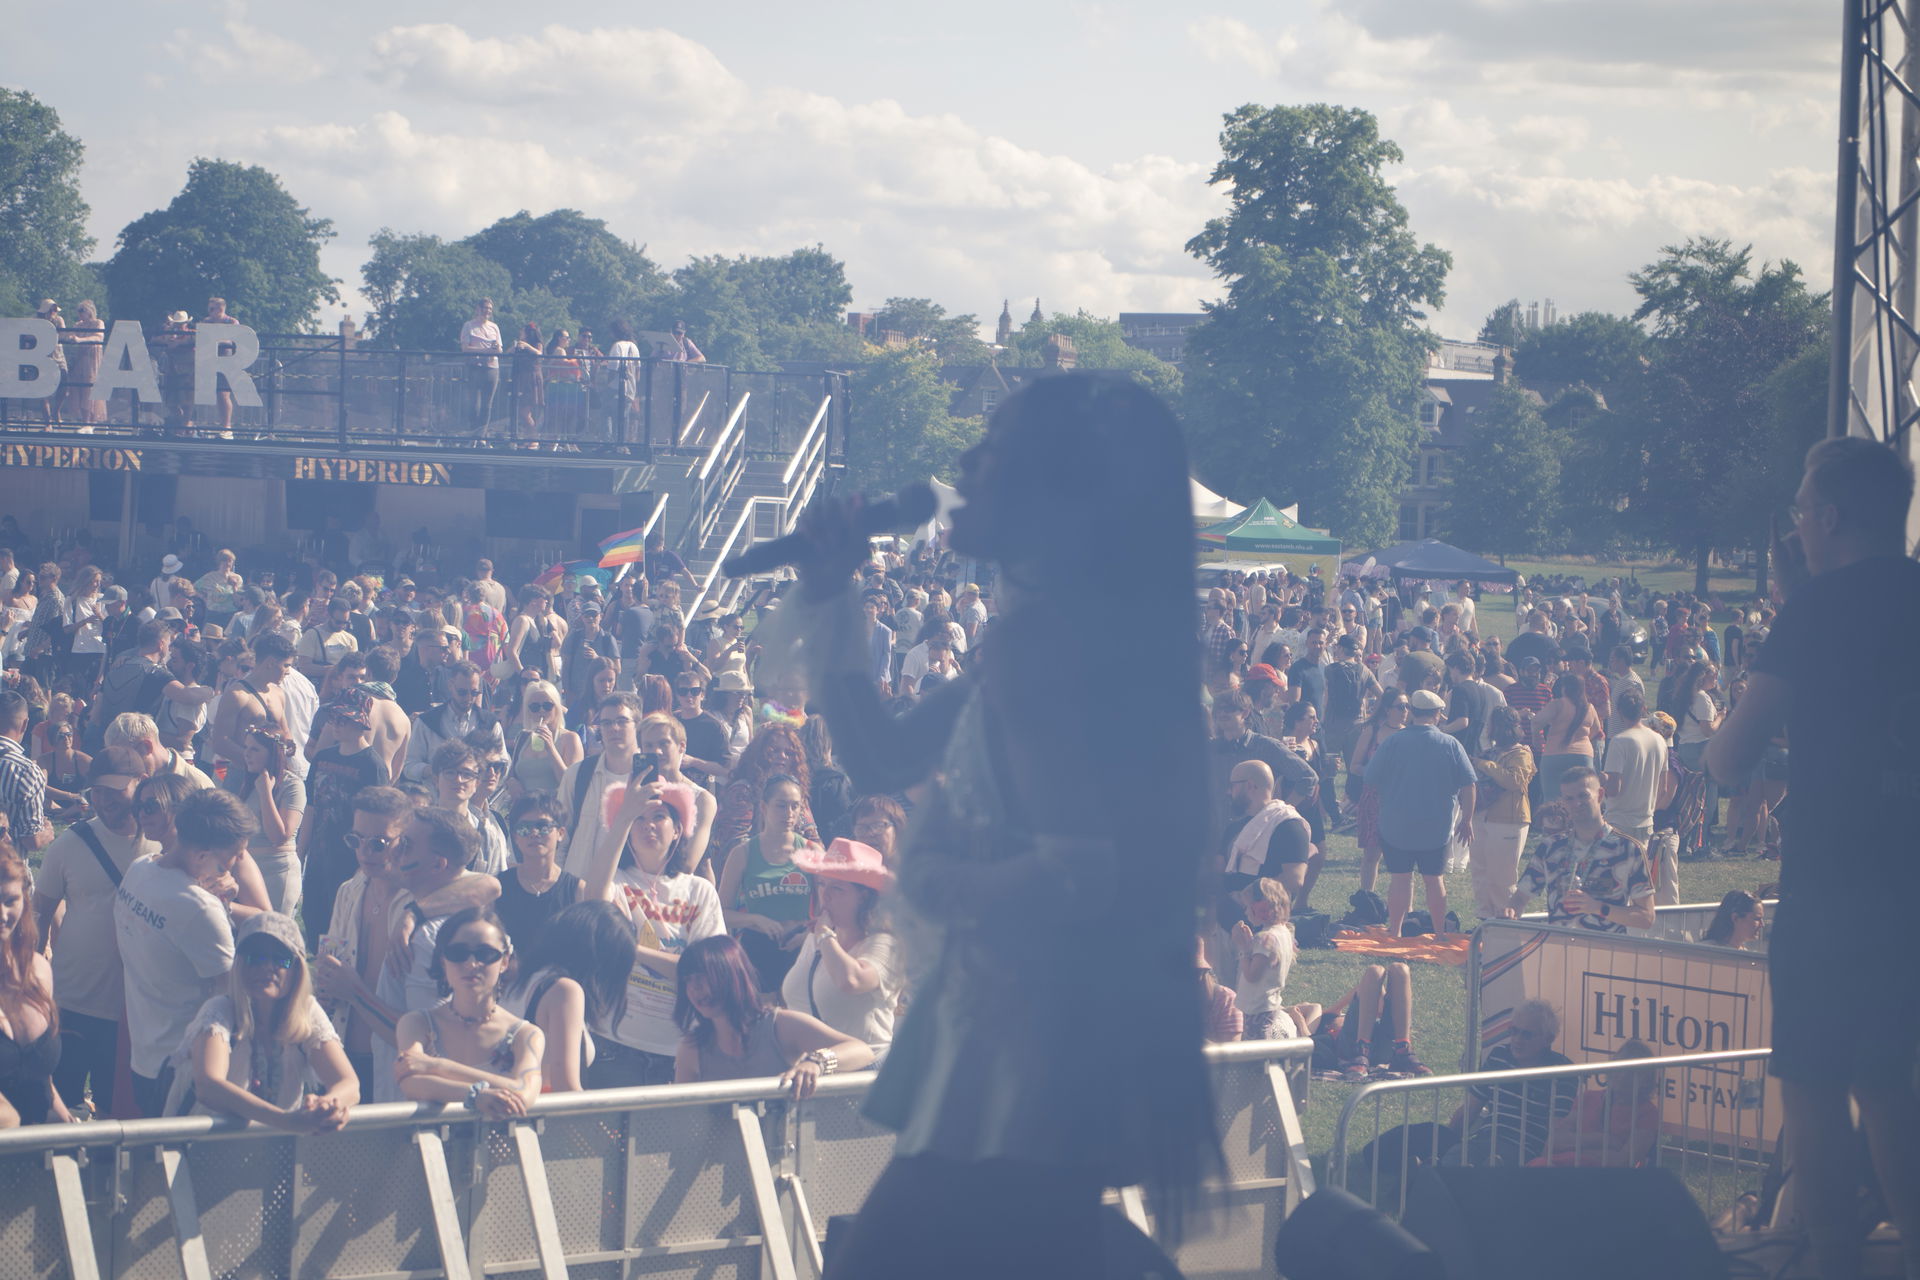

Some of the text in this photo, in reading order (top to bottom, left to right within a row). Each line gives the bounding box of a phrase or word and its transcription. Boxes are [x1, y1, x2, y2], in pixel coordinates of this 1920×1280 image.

[0, 317, 264, 407] BAR
[0, 443, 144, 472] HYPERION
[292, 456, 453, 486] HYPERION
[132, 900, 167, 929] JEANS
[1593, 990, 1730, 1052] Hilton
[1687, 1081, 1739, 1110] STAY
